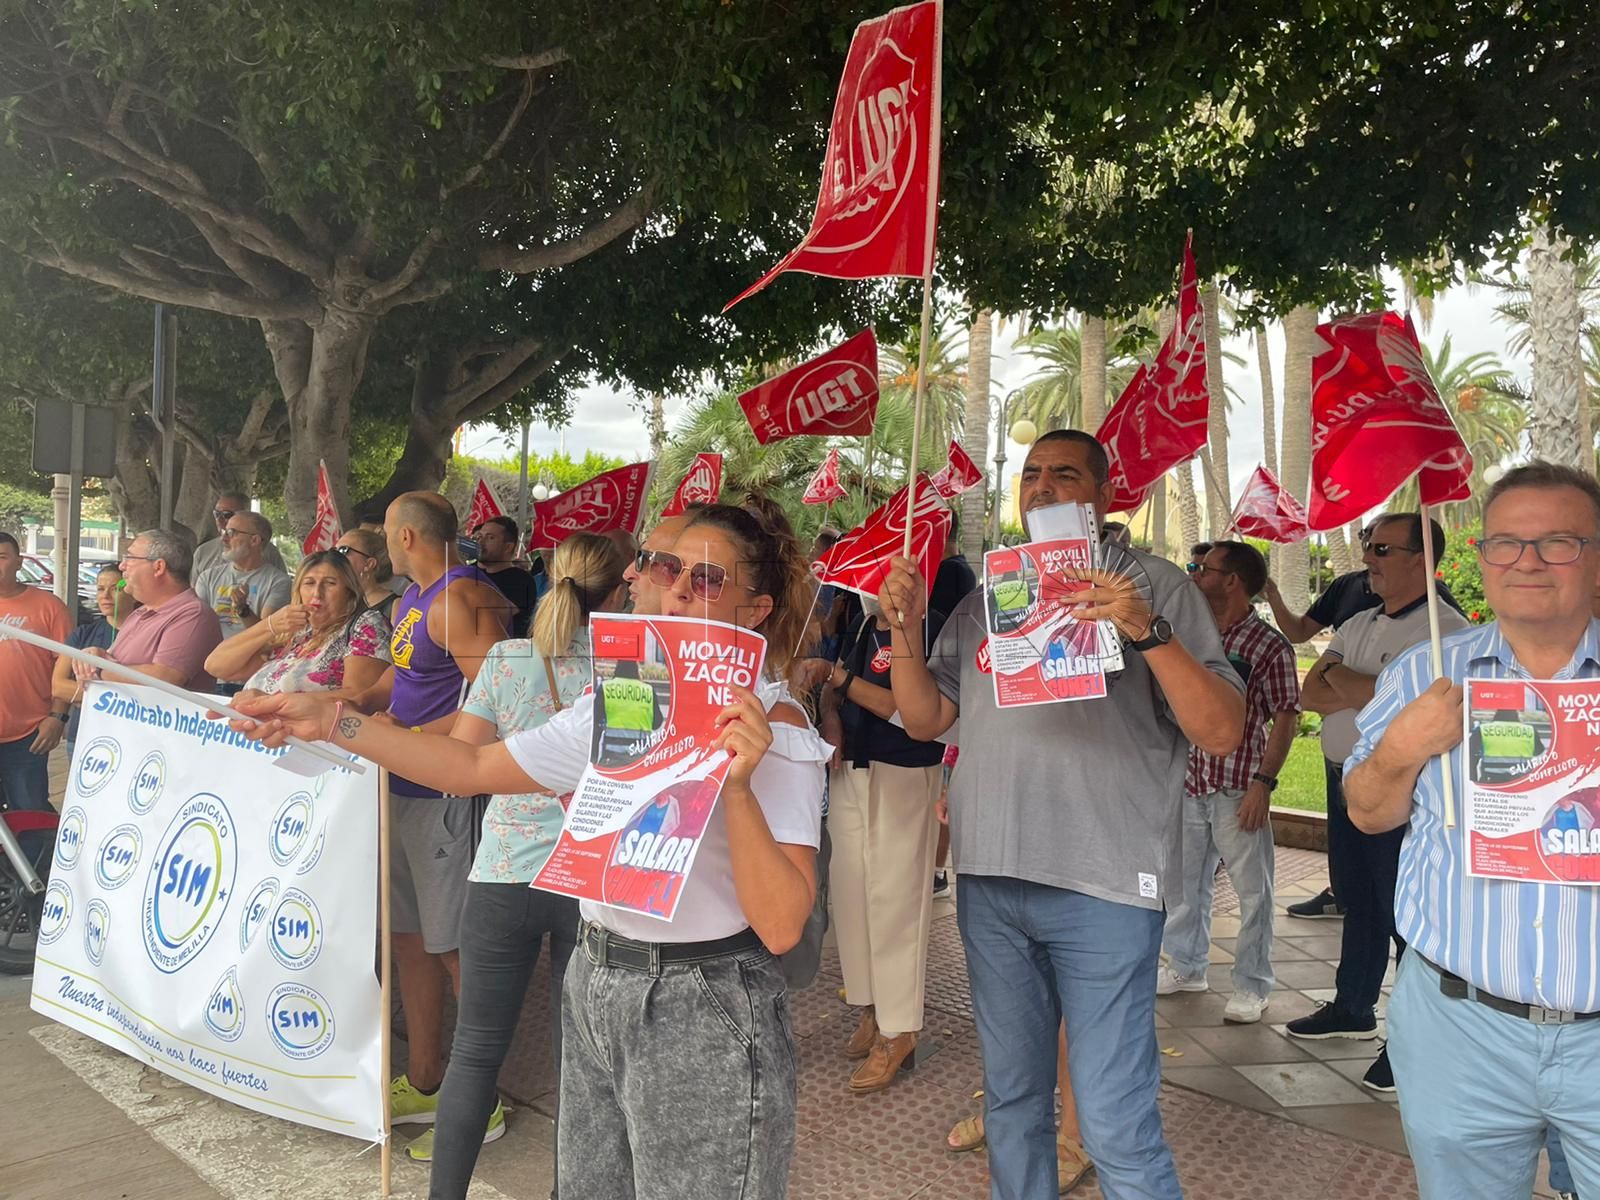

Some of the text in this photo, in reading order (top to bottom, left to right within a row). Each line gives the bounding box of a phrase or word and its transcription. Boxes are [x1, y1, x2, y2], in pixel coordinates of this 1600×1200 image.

[796, 368, 864, 426] UGT
[601, 635, 614, 643] UGT
[678, 640, 756, 670] MOVILI
[683, 662, 752, 688] ZACIO
[605, 683, 652, 704] SEGURIDAD
[708, 685, 735, 706] NE
[93, 691, 172, 728] Sindicato
[628, 724, 676, 756] SALARIO O
[1483, 725, 1534, 738] SEGURIDAD
[643, 736, 694, 768] CONFLICTO
[1509, 751, 1558, 776] SALARIO O
[84, 757, 109, 775] SIM
[1528, 758, 1578, 782] CONFLICTO
[140, 773, 158, 792] SIM
[584, 786, 606, 794] ESTATAL
[606, 781, 634, 790] CONVENIO
[182, 802, 228, 838] SINDICATO
[280, 816, 304, 838] SIM
[62, 828, 78, 846] SIM
[106, 846, 132, 866] SIM
[163, 854, 212, 908] SIM
[146, 897, 170, 967] INDEPENDIENTE
[177, 924, 210, 964] MELILLA
[277, 916, 309, 940] SIM
[276, 986, 318, 1000] SINDICATO
[278, 1010, 319, 1028] SIM
[58, 975, 269, 1092] Nuestra independencia nos hace fuertes
